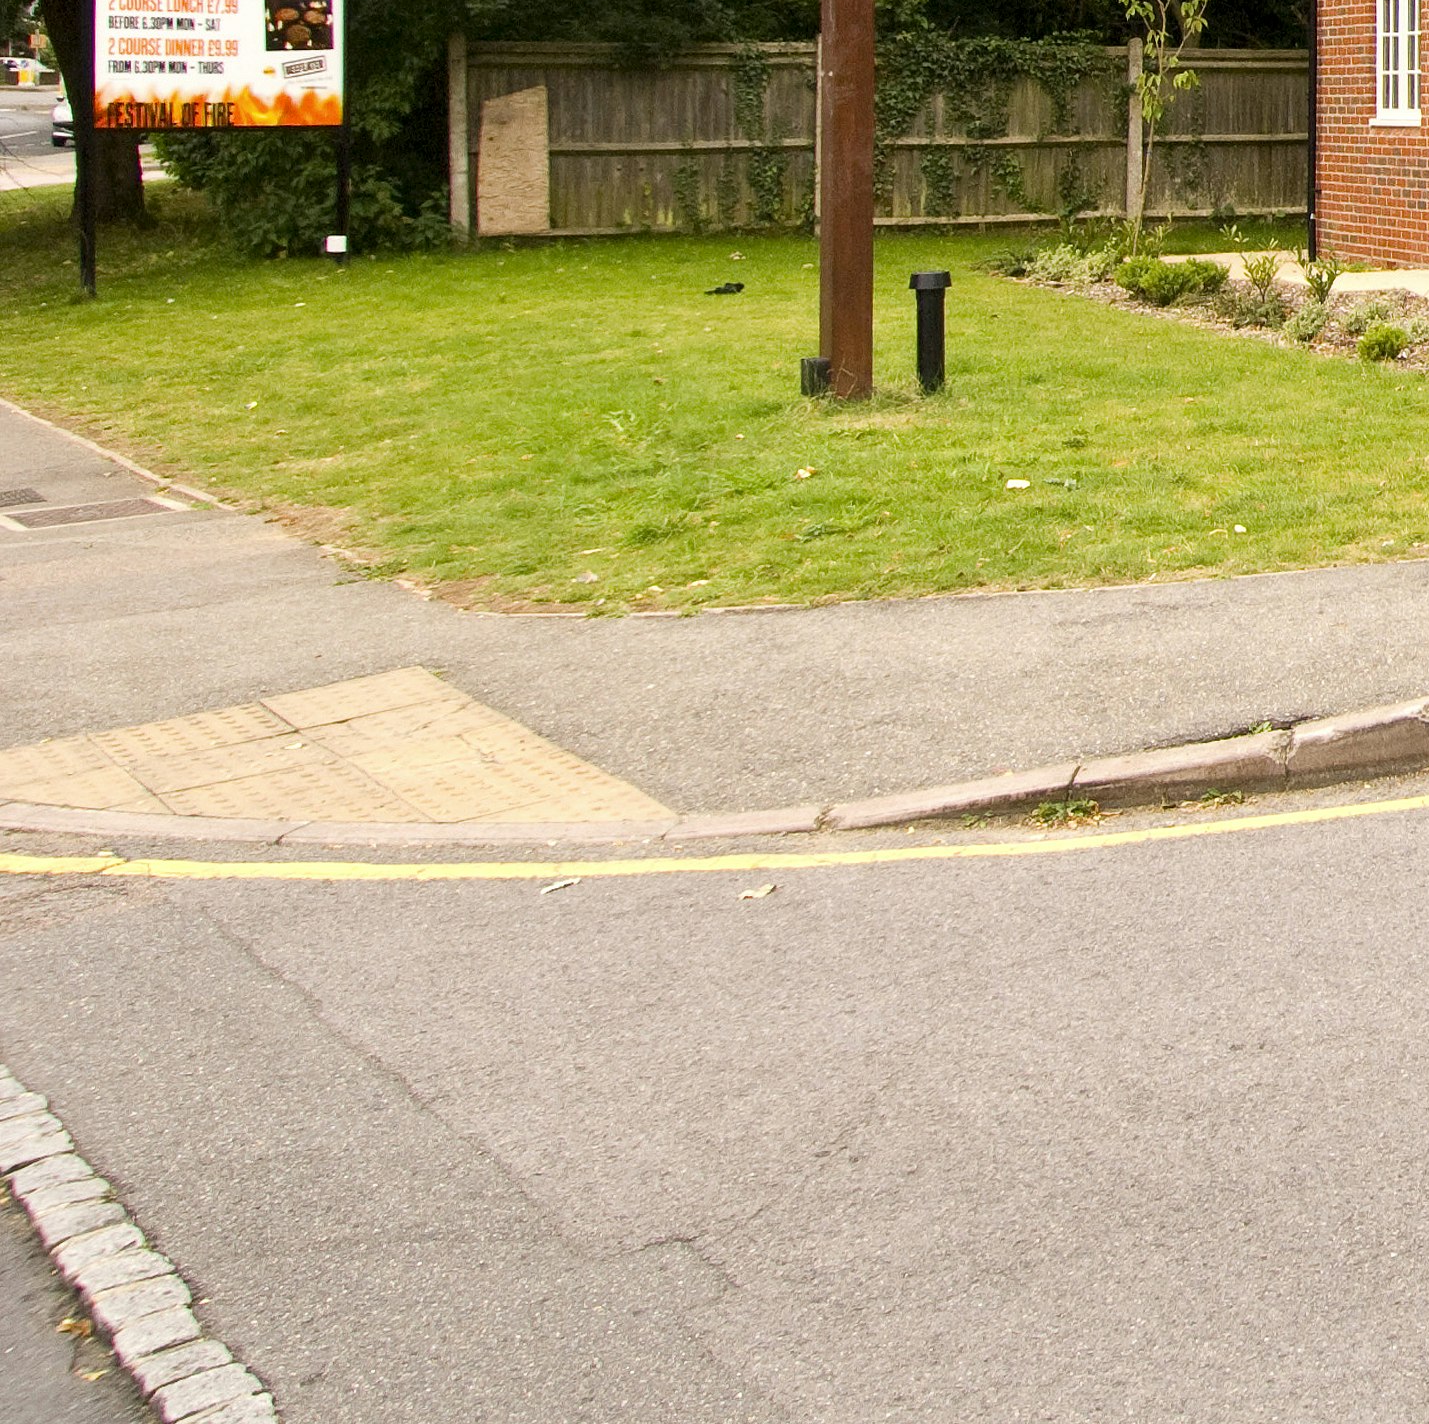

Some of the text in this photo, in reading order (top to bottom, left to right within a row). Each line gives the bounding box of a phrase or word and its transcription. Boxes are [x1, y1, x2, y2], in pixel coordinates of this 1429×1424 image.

[108, 15, 140, 30] BEFORE
[142, 16, 174, 31] 6.30PM
[176, 17, 195, 31] MON
[205, 18, 222, 32] SAT
[108, 37, 239, 58] 2 COURSE DINNER £9.99
[108, 60, 132, 73] FROM
[134, 60, 166, 74] 6.30PM
[168, 61, 188, 74] MON
[198, 61, 225, 75] THURS
[107, 102, 236, 127] FESTIVAL OF FIRE
